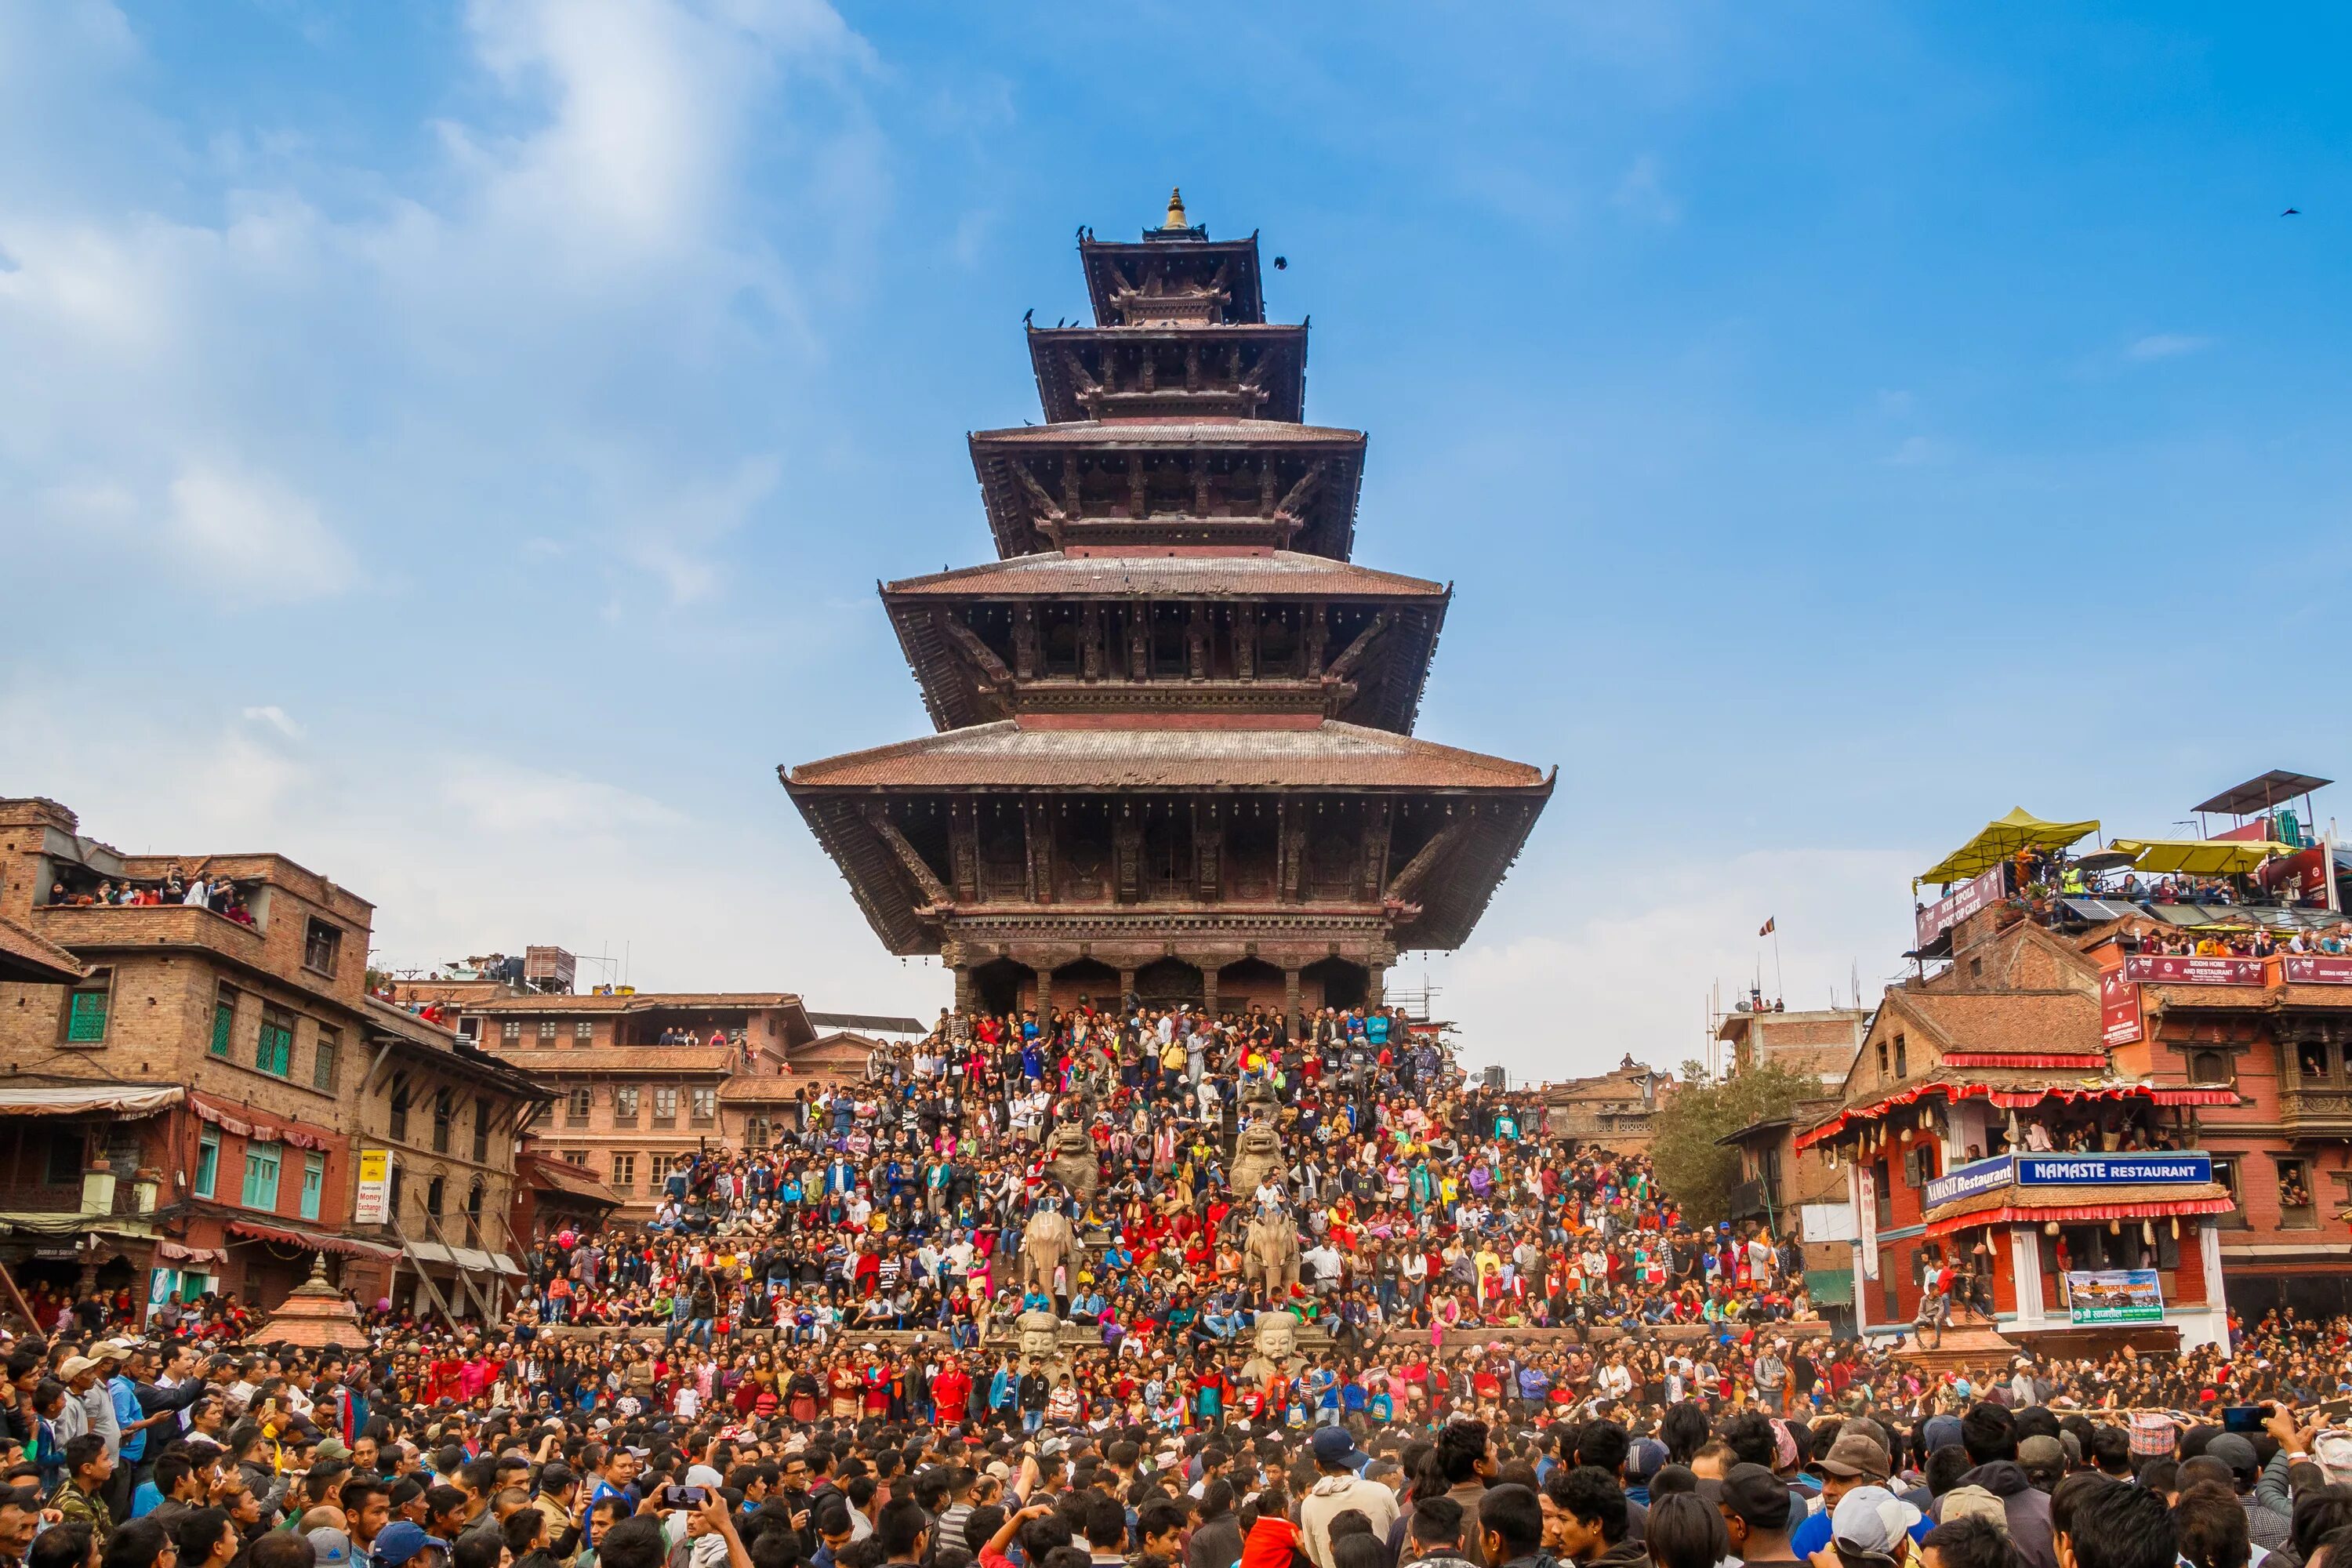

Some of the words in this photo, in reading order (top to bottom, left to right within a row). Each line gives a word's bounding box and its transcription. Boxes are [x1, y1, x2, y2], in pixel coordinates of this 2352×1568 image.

[1941, 885, 1975, 914] NYAAPOLA
[2034, 1163, 2106, 1180] NAMASTE
[2111, 1166, 2196, 1178] RESTAURANT
[1927, 1177, 1958, 1203] NAMASTE
[1958, 1165, 2012, 1192] Restaurant
[360, 1192, 382, 1203] Money
[358, 1203, 382, 1213] Exchange
